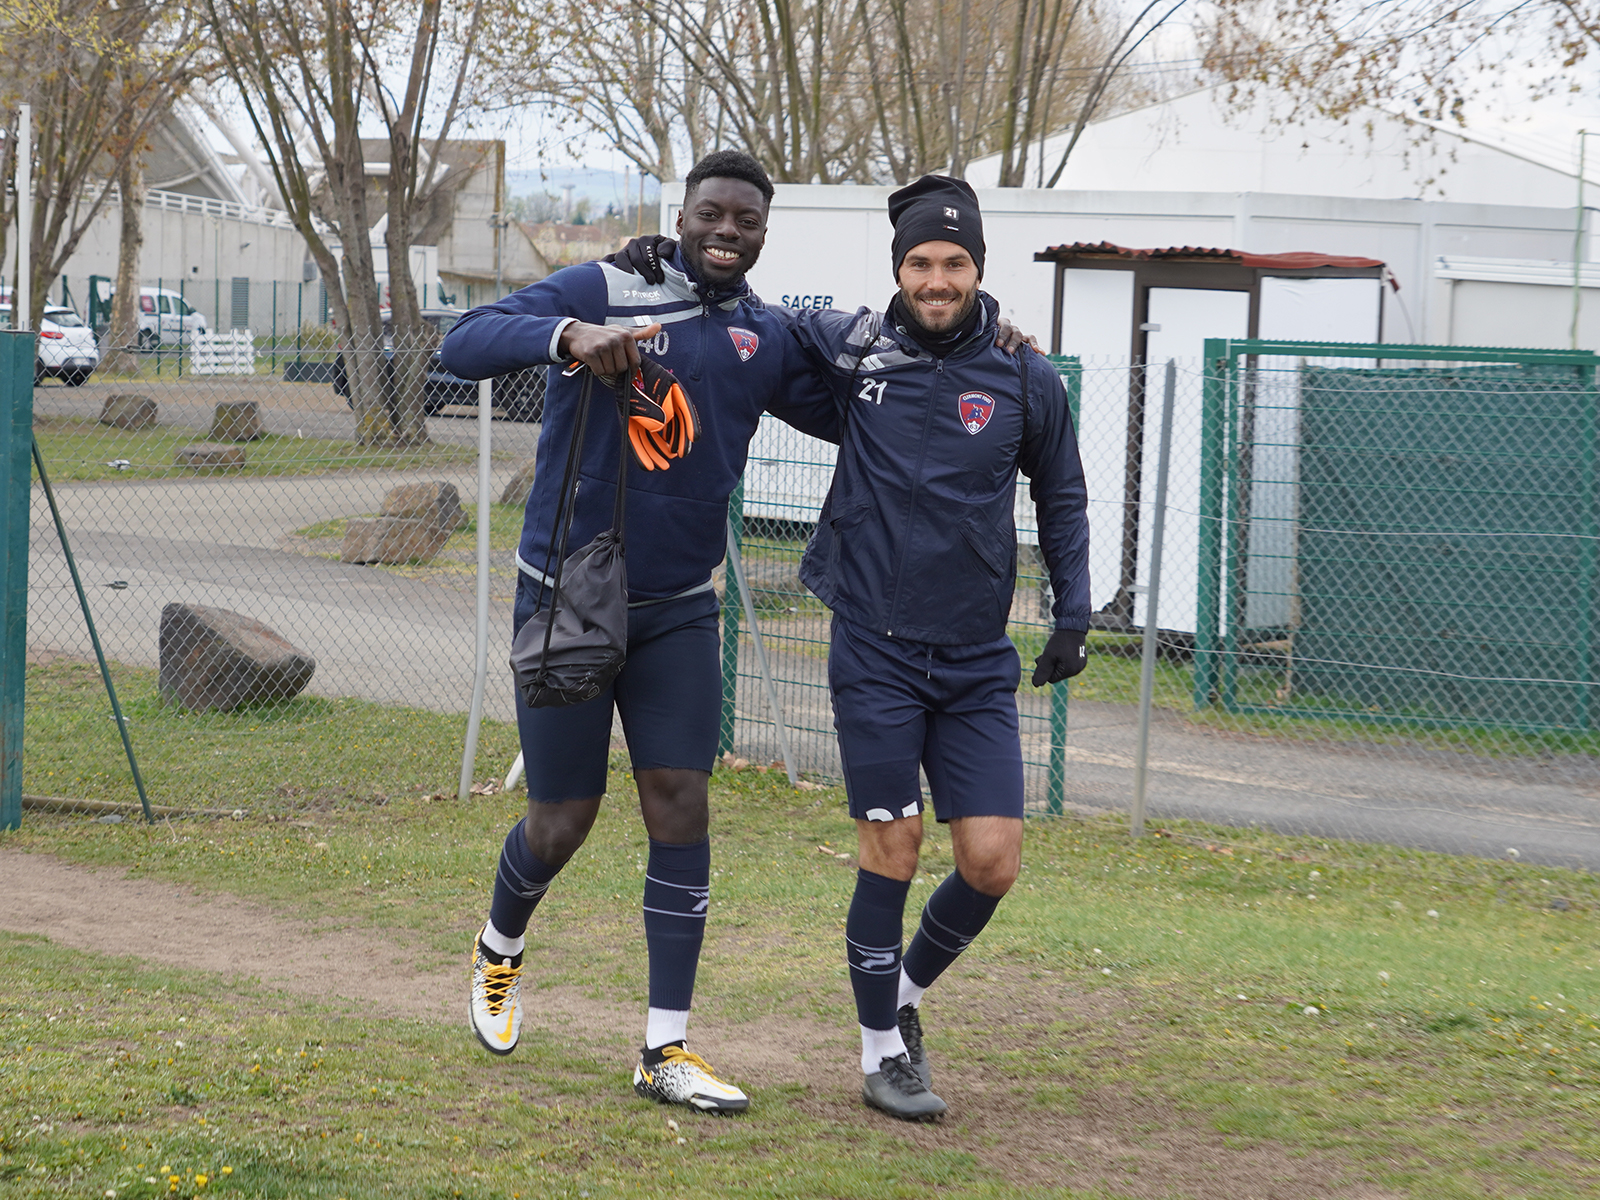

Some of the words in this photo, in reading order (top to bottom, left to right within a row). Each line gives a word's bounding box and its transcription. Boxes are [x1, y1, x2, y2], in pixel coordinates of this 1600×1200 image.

[945, 207, 957, 219] 21
[646, 245, 656, 270] KIPSTA
[780, 294, 834, 310] SACER
[637, 330, 670, 356] 40
[858, 377, 888, 405] 21
[962, 393, 982, 401] CLERMONT
